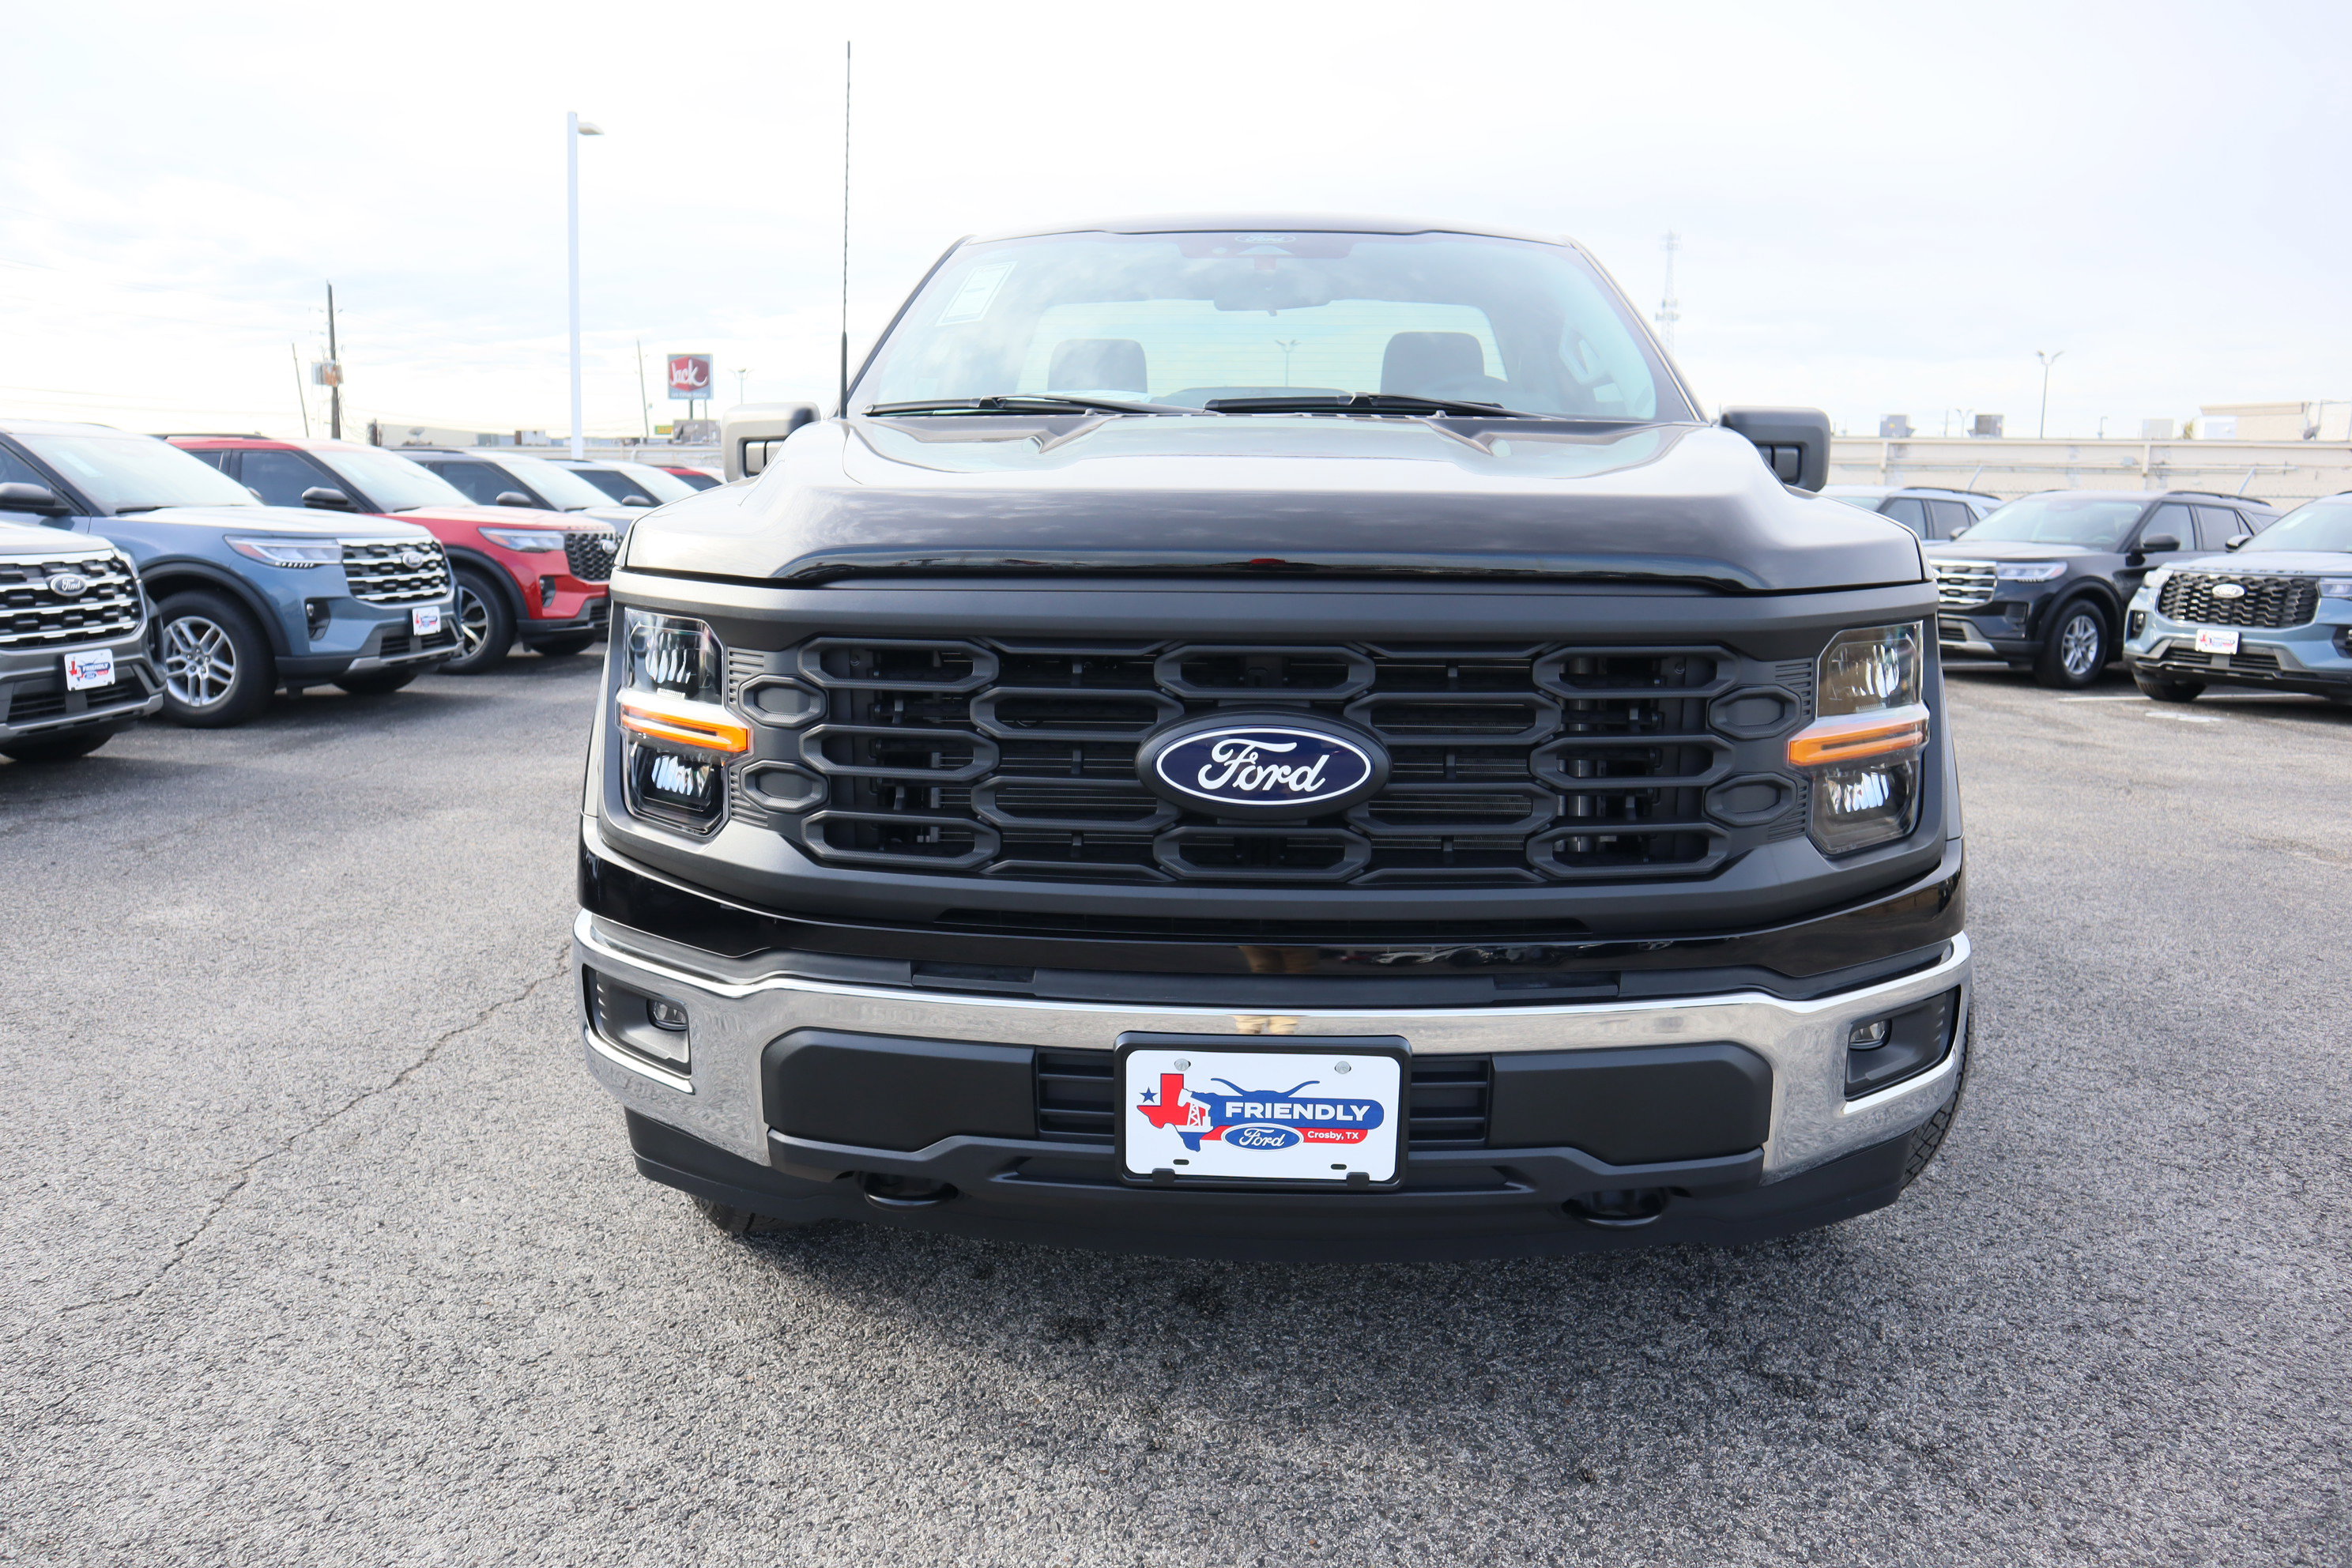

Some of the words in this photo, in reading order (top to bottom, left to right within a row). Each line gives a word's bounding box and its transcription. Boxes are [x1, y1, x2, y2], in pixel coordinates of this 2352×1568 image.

[669, 358, 707, 387] Jack
[82, 662, 108, 672] FRIENDLY
[1197, 738, 1330, 792] Ford
[1225, 1101, 1370, 1121] FRIENDLY
[1238, 1128, 1287, 1147] Ford
[1307, 1130, 1344, 1140] Crosby,
